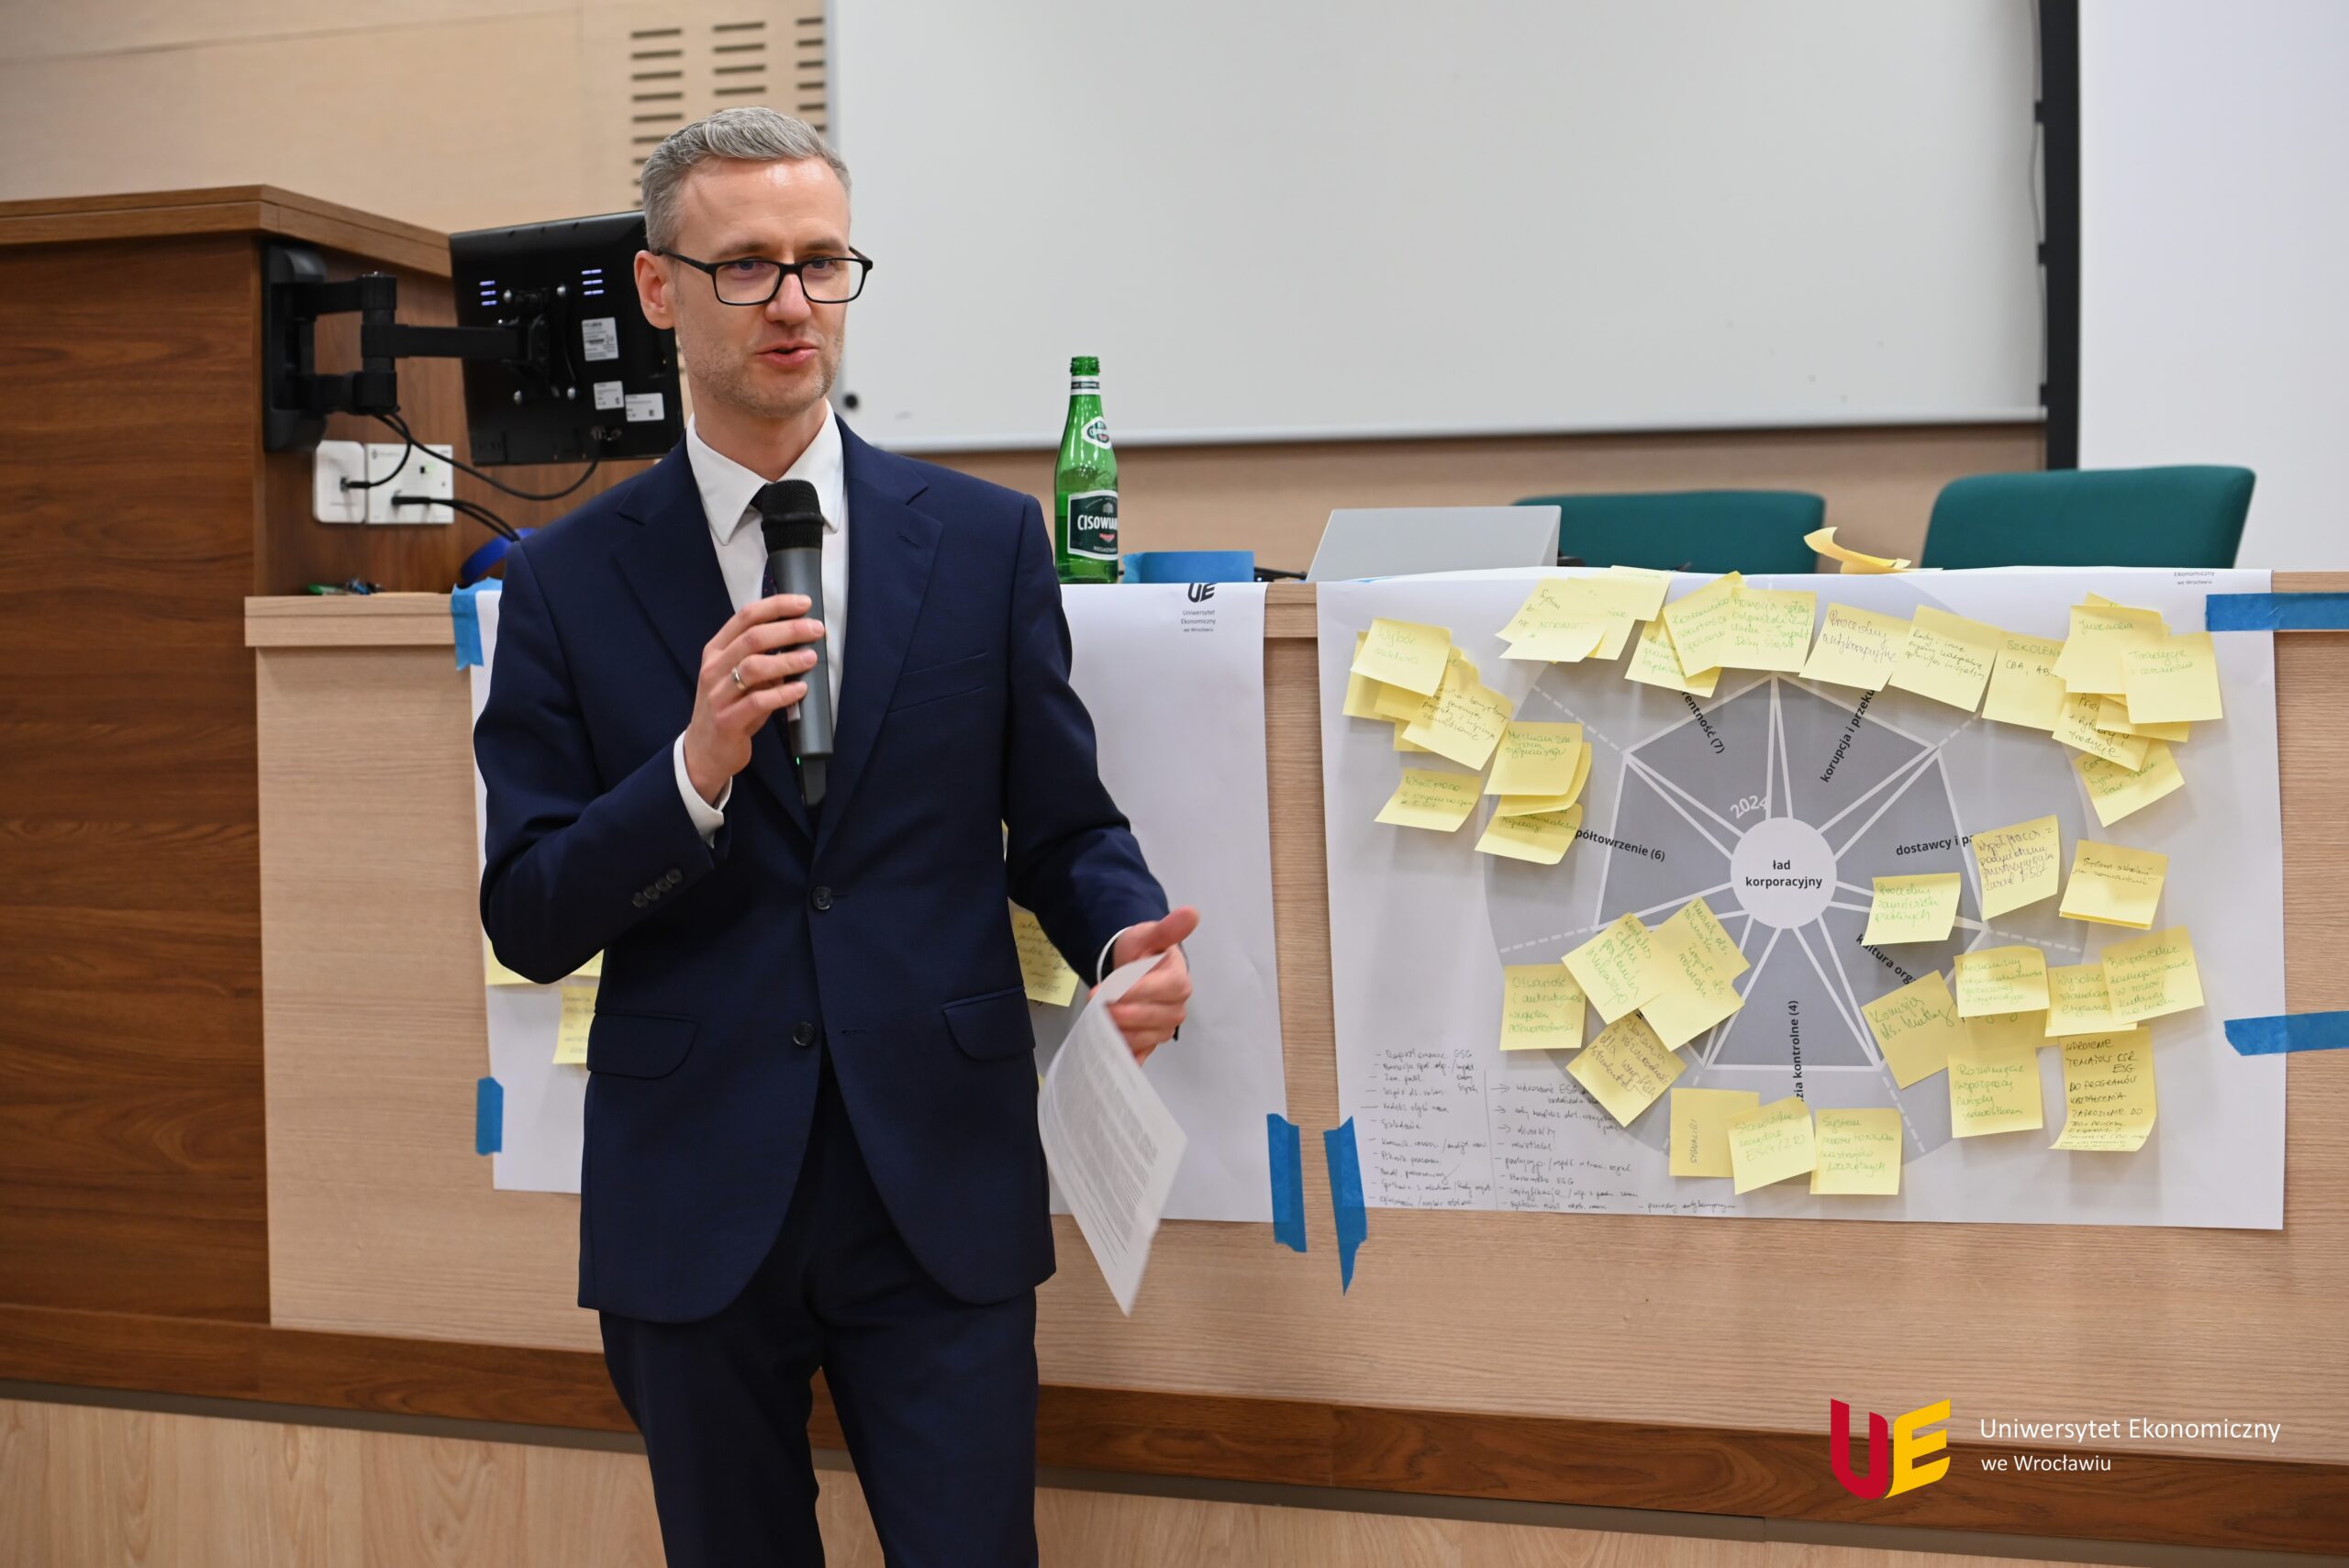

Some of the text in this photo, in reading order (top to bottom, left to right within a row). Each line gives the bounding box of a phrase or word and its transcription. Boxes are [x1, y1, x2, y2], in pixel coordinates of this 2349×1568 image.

[1077, 515, 1118, 530] CISOWIA
[1710, 738, 1725, 754] (7)
[1820, 733, 1852, 784] korupcja
[1896, 839, 1952, 856] dostawcy
[1954, 835, 1960, 846] i
[1651, 849, 1665, 862] (6)
[1773, 860, 1791, 870] ład
[1745, 876, 1823, 889] korporacyjny
[1788, 1000, 1799, 1016] (4)
[1789, 1018, 1802, 1078] kontrolne
